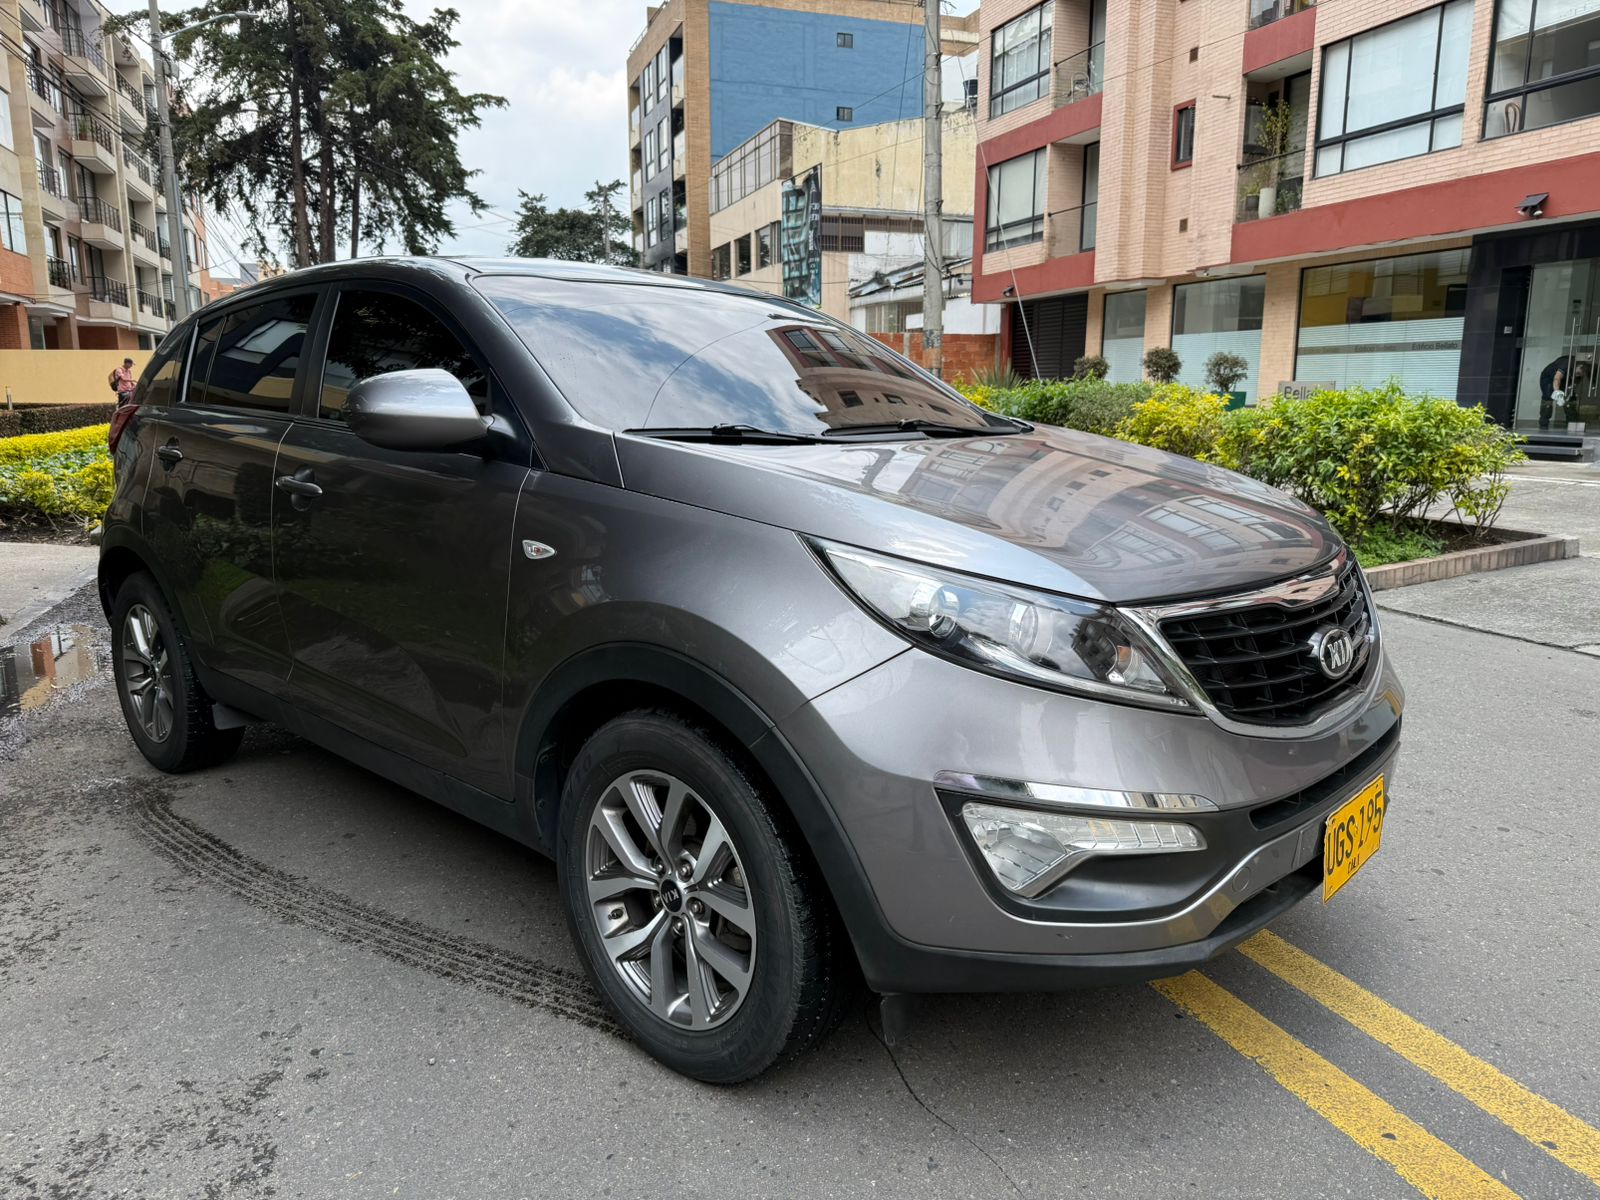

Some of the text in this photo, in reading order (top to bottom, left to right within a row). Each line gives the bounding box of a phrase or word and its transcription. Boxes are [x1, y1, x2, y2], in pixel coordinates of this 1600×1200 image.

[1284, 386, 1315, 400] Bella
[1327, 790, 1382, 875] UGS 195
[661, 888, 680, 904] KIA
